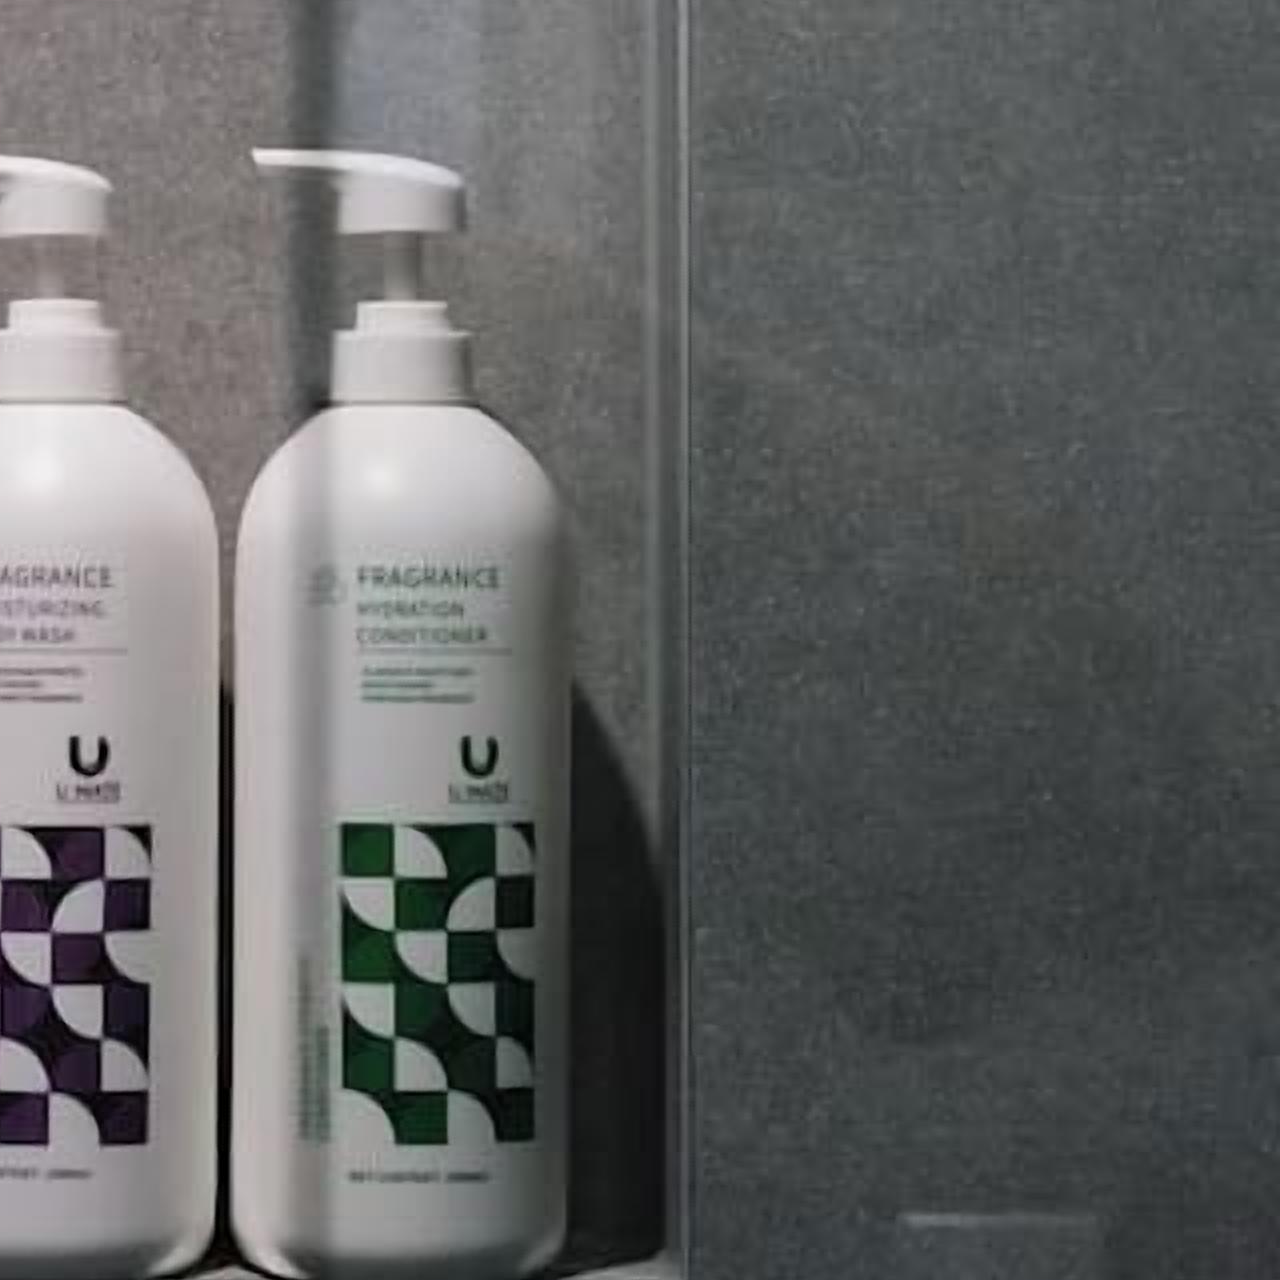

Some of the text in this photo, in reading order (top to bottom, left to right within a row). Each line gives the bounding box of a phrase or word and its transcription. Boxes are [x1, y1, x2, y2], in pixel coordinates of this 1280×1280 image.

[356, 565, 500, 589] FRAGRANCE
[68, 735, 111, 778] U
[460, 735, 499, 779] U
